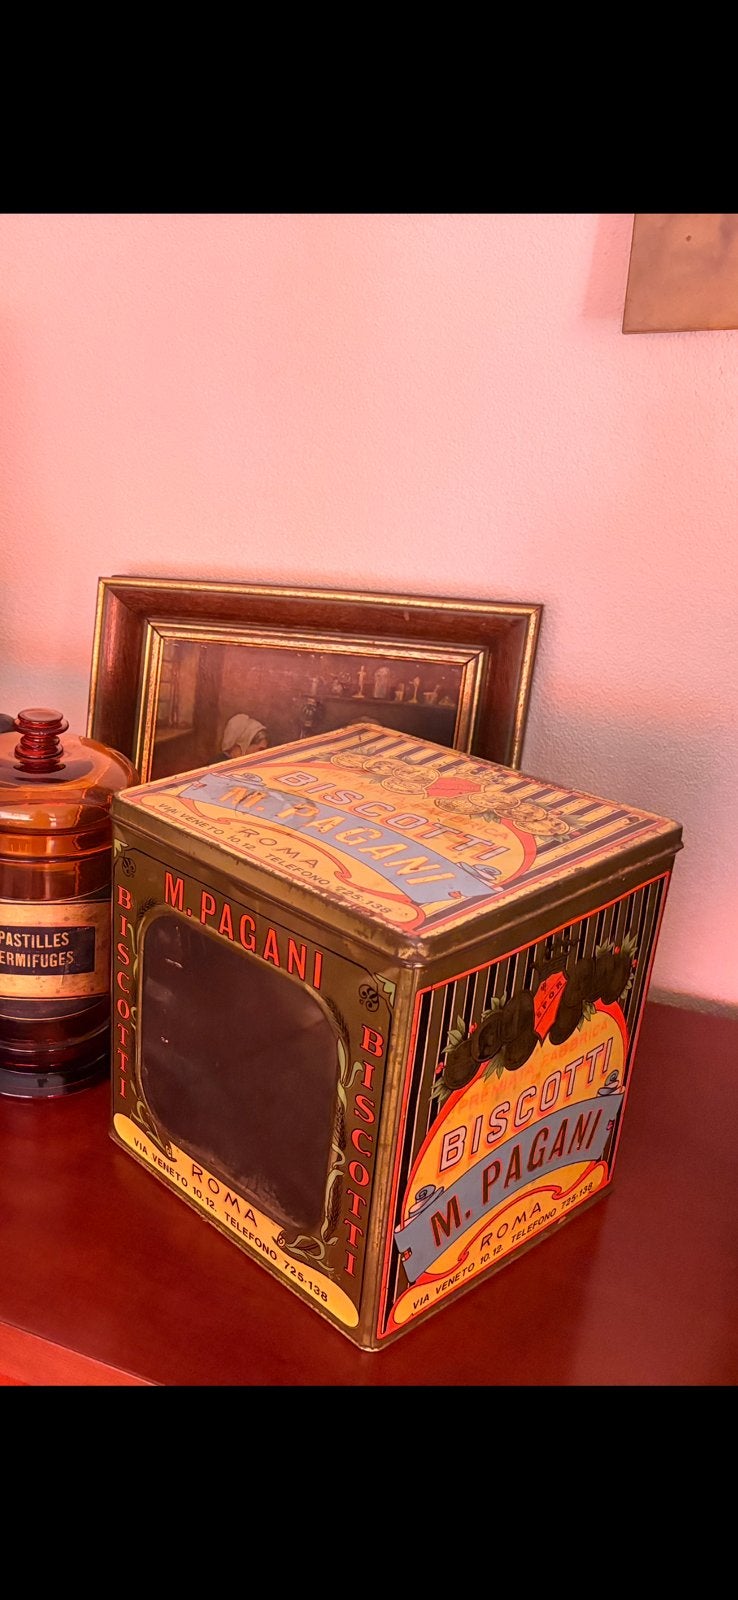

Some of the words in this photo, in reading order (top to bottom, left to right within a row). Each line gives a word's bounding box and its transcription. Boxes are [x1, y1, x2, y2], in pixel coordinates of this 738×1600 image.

[158, 803, 178, 814] VIA
[180, 813, 224, 835] VENETO
[265, 853, 330, 885] TELEFONO
[238, 828, 319, 868] ROMA
[276, 802, 456, 885] PAGANI
[277, 770, 511, 861] BISCOTTI
[0, 931, 70, 949] PASTILLES
[200, 889, 324, 990] PAGANI
[116, 885, 133, 1098] BISCOTTI
[343, 1024, 384, 1277] BISCOTTI
[438, 1037, 614, 1173] BISCOTTI
[133, 1138, 148, 1156] VIA
[152, 1152, 188, 1188] VENETO
[224, 1211, 278, 1261] TELEFONO
[192, 1163, 258, 1228] ROMA
[430, 1194, 471, 1247] M.
[482, 1109, 602, 1205] PAGANI
[412, 1294, 430, 1310] VIA
[435, 1262, 475, 1295] VENETO
[511, 1208, 557, 1243] TELEFONO
[480, 1202, 542, 1251] ROMA
